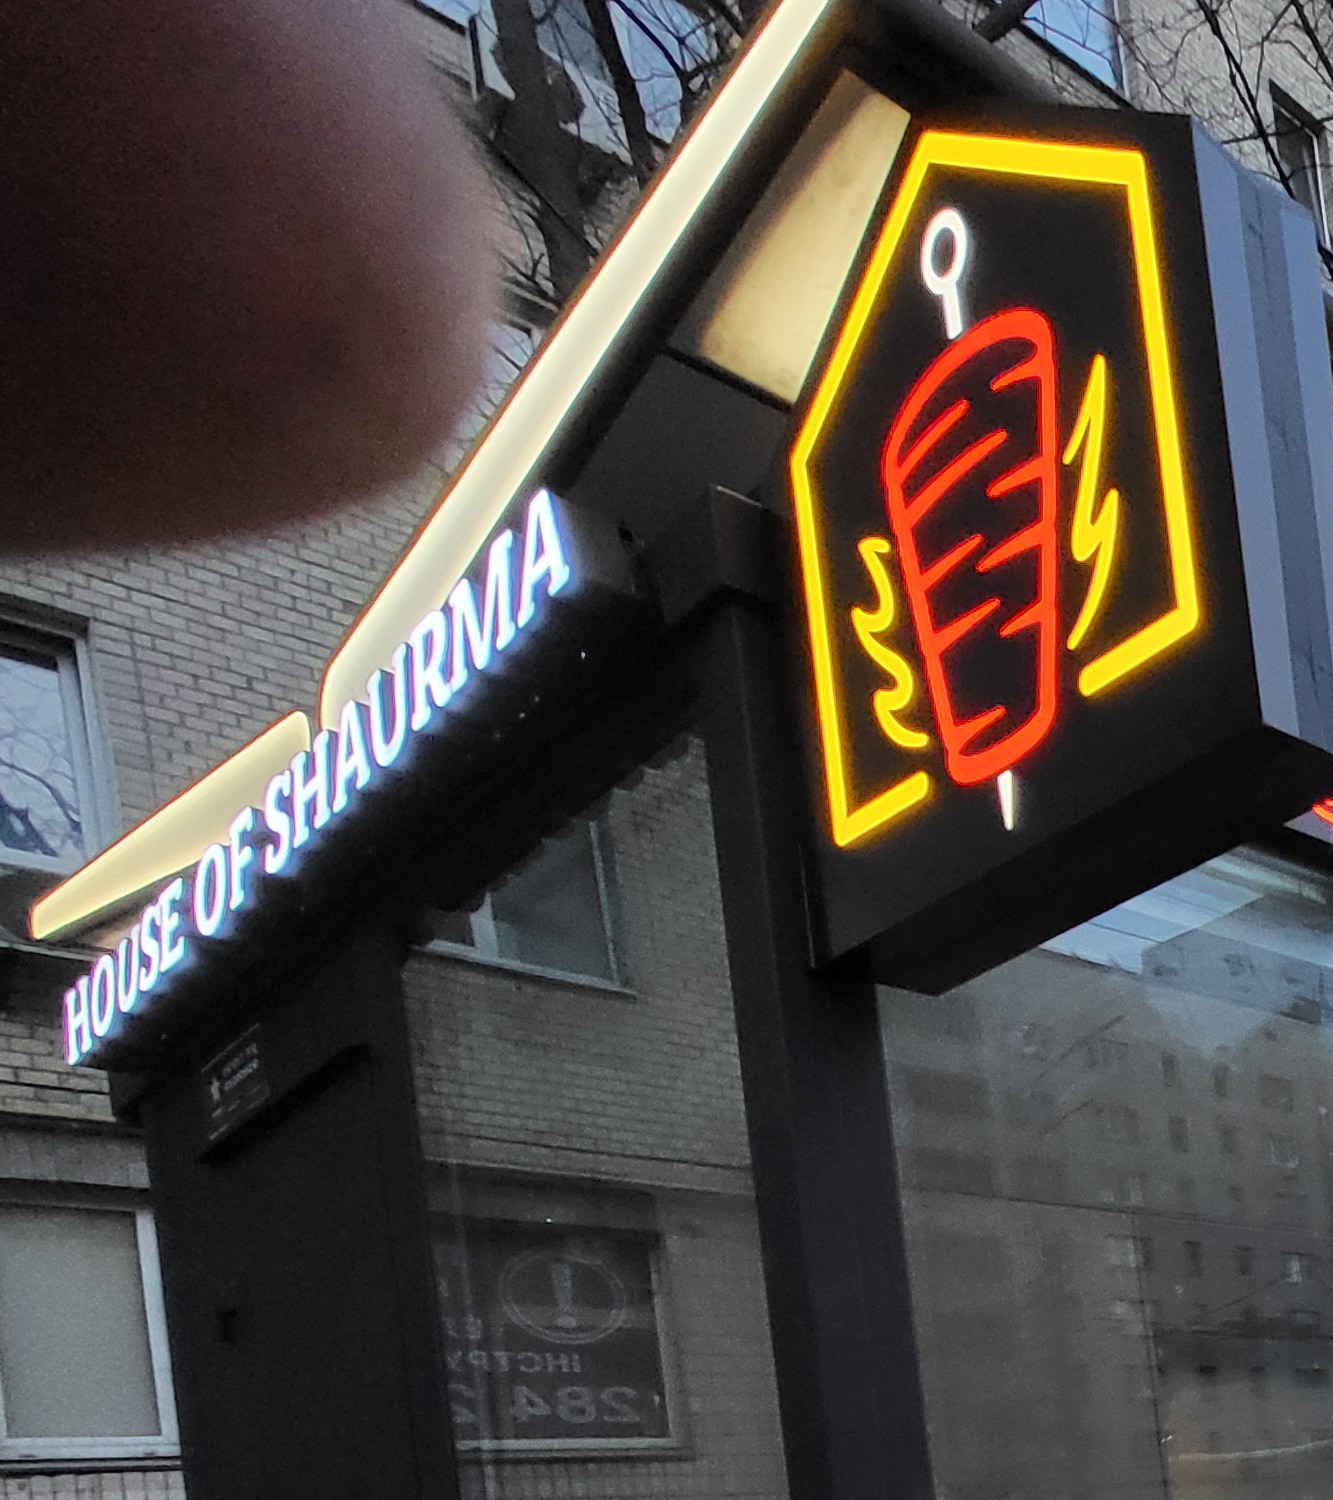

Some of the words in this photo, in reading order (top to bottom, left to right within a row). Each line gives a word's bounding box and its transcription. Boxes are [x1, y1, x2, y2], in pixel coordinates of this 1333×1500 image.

[65, 877, 187, 1065] HOUSE
[194, 806, 257, 936] OF
[264, 488, 570, 875] SHAURMA
